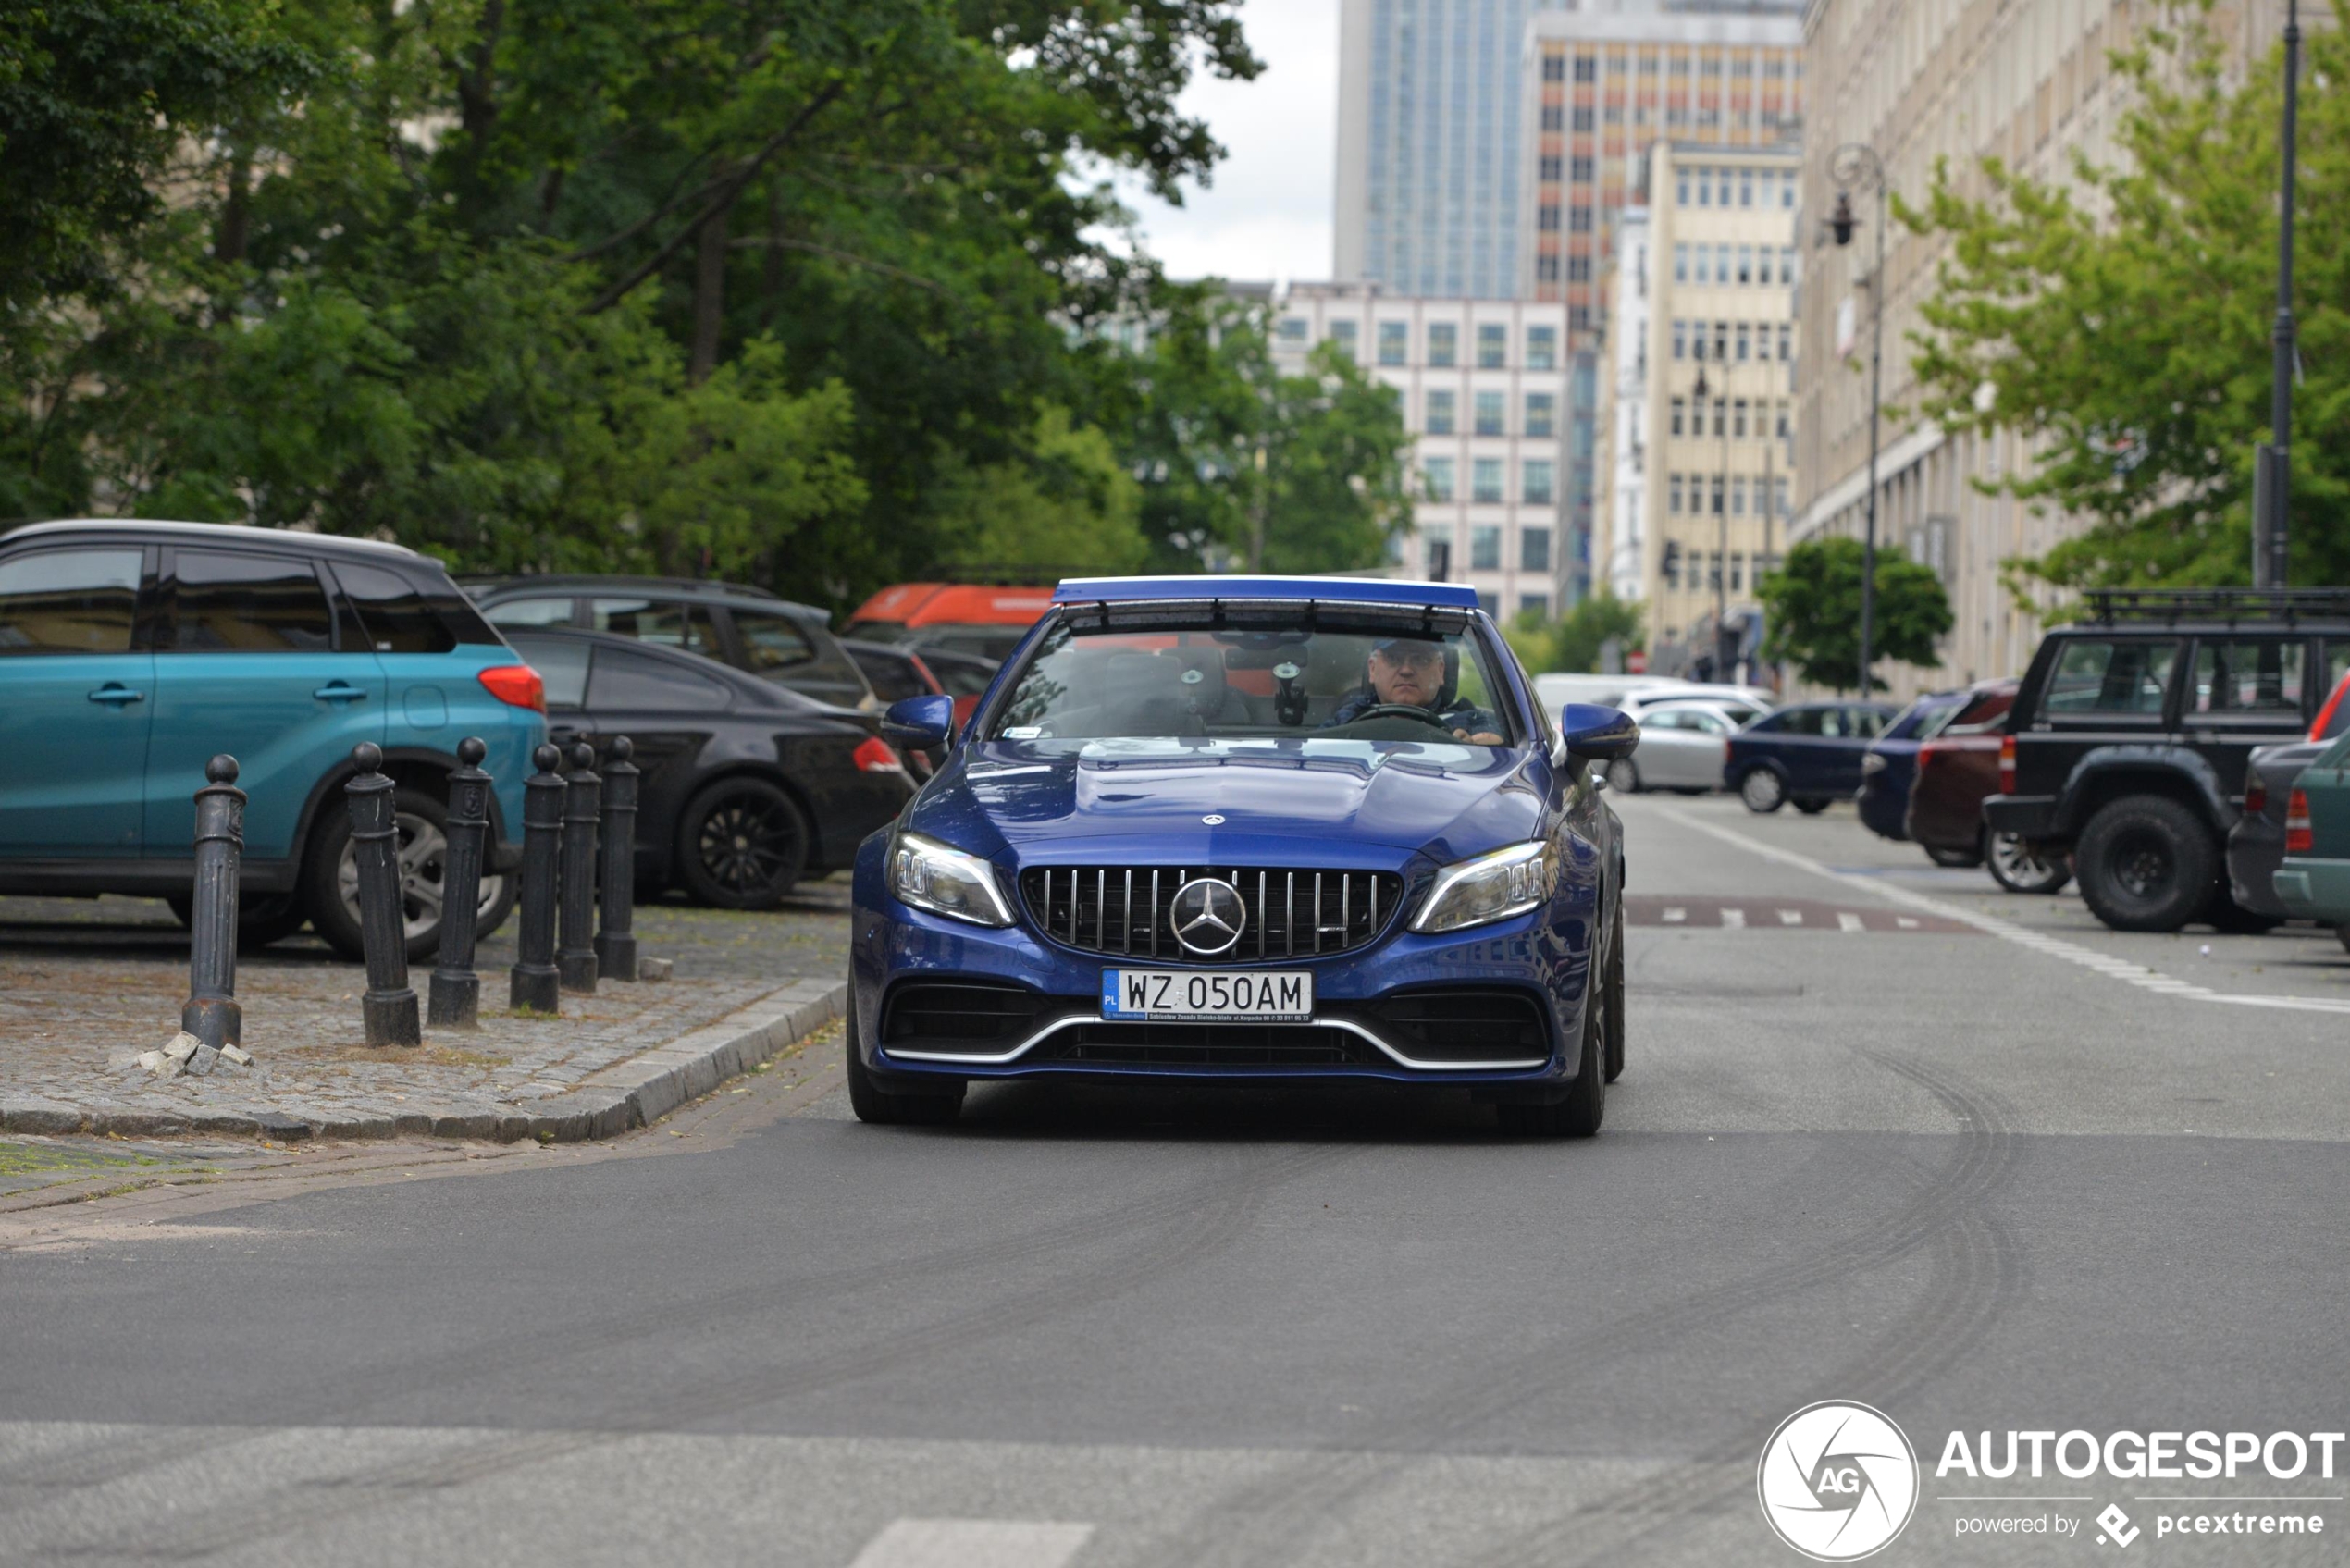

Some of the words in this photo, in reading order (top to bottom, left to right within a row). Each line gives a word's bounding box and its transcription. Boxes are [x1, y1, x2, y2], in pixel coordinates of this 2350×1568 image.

[1104, 995, 1117, 1006] PL
[1128, 975, 1172, 1009] WZ
[1188, 976, 1301, 1010] 050AM
